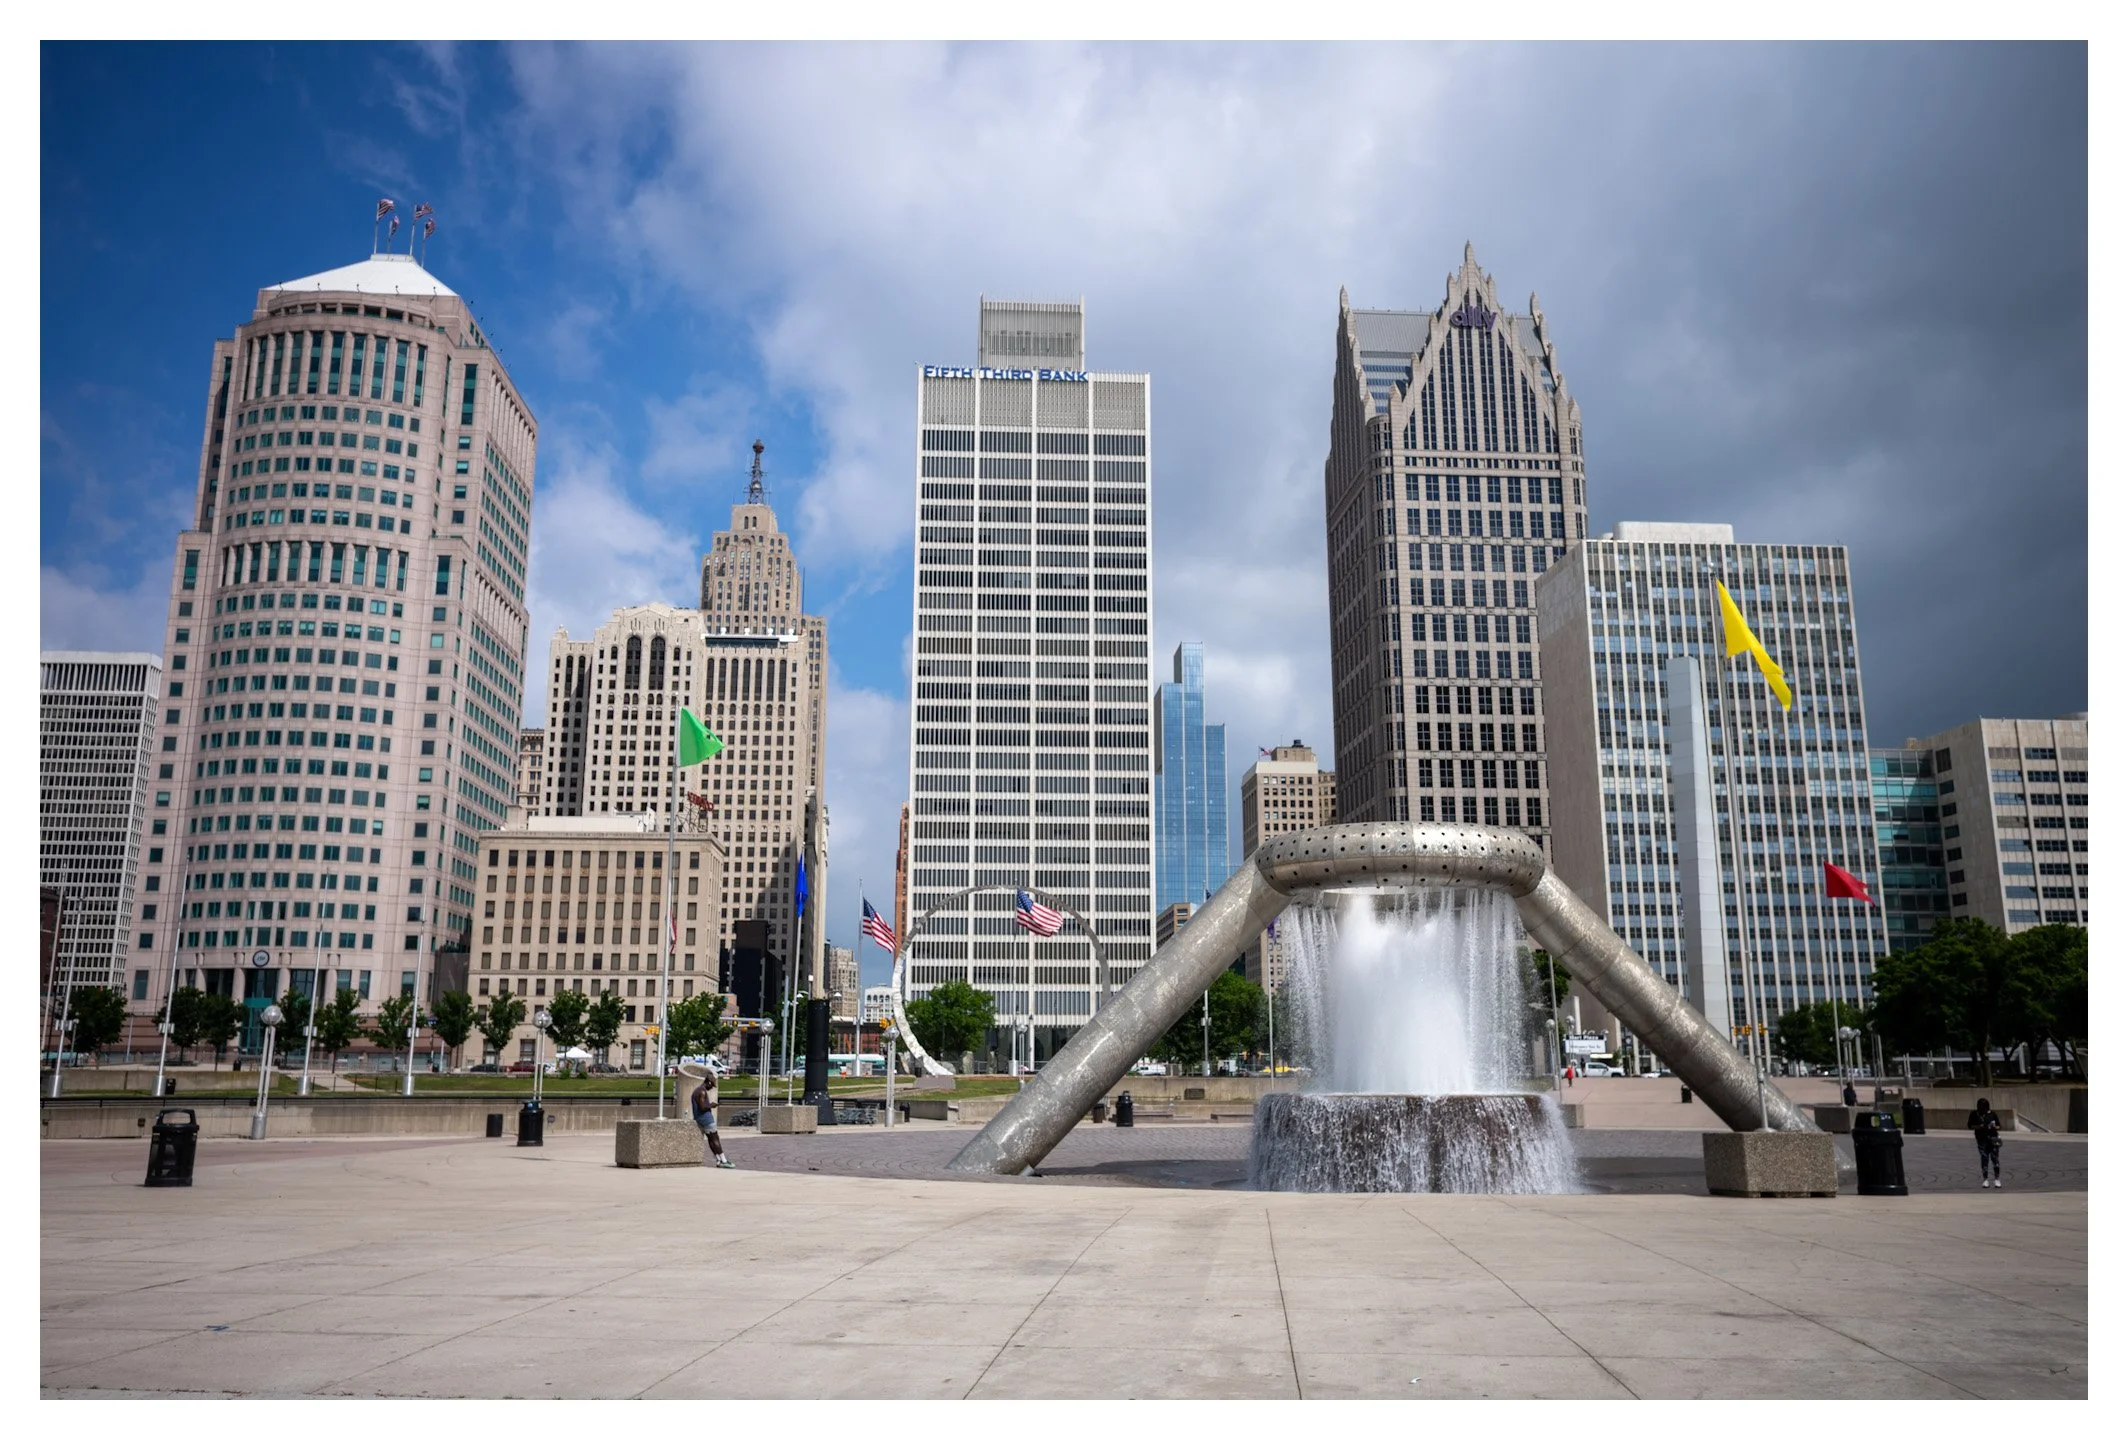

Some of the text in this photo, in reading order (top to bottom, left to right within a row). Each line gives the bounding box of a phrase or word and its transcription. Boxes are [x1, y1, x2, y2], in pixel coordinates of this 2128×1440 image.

[1450, 305, 1497, 332] ally
[923, 365, 1088, 382] FIFTH THIRD BANK
